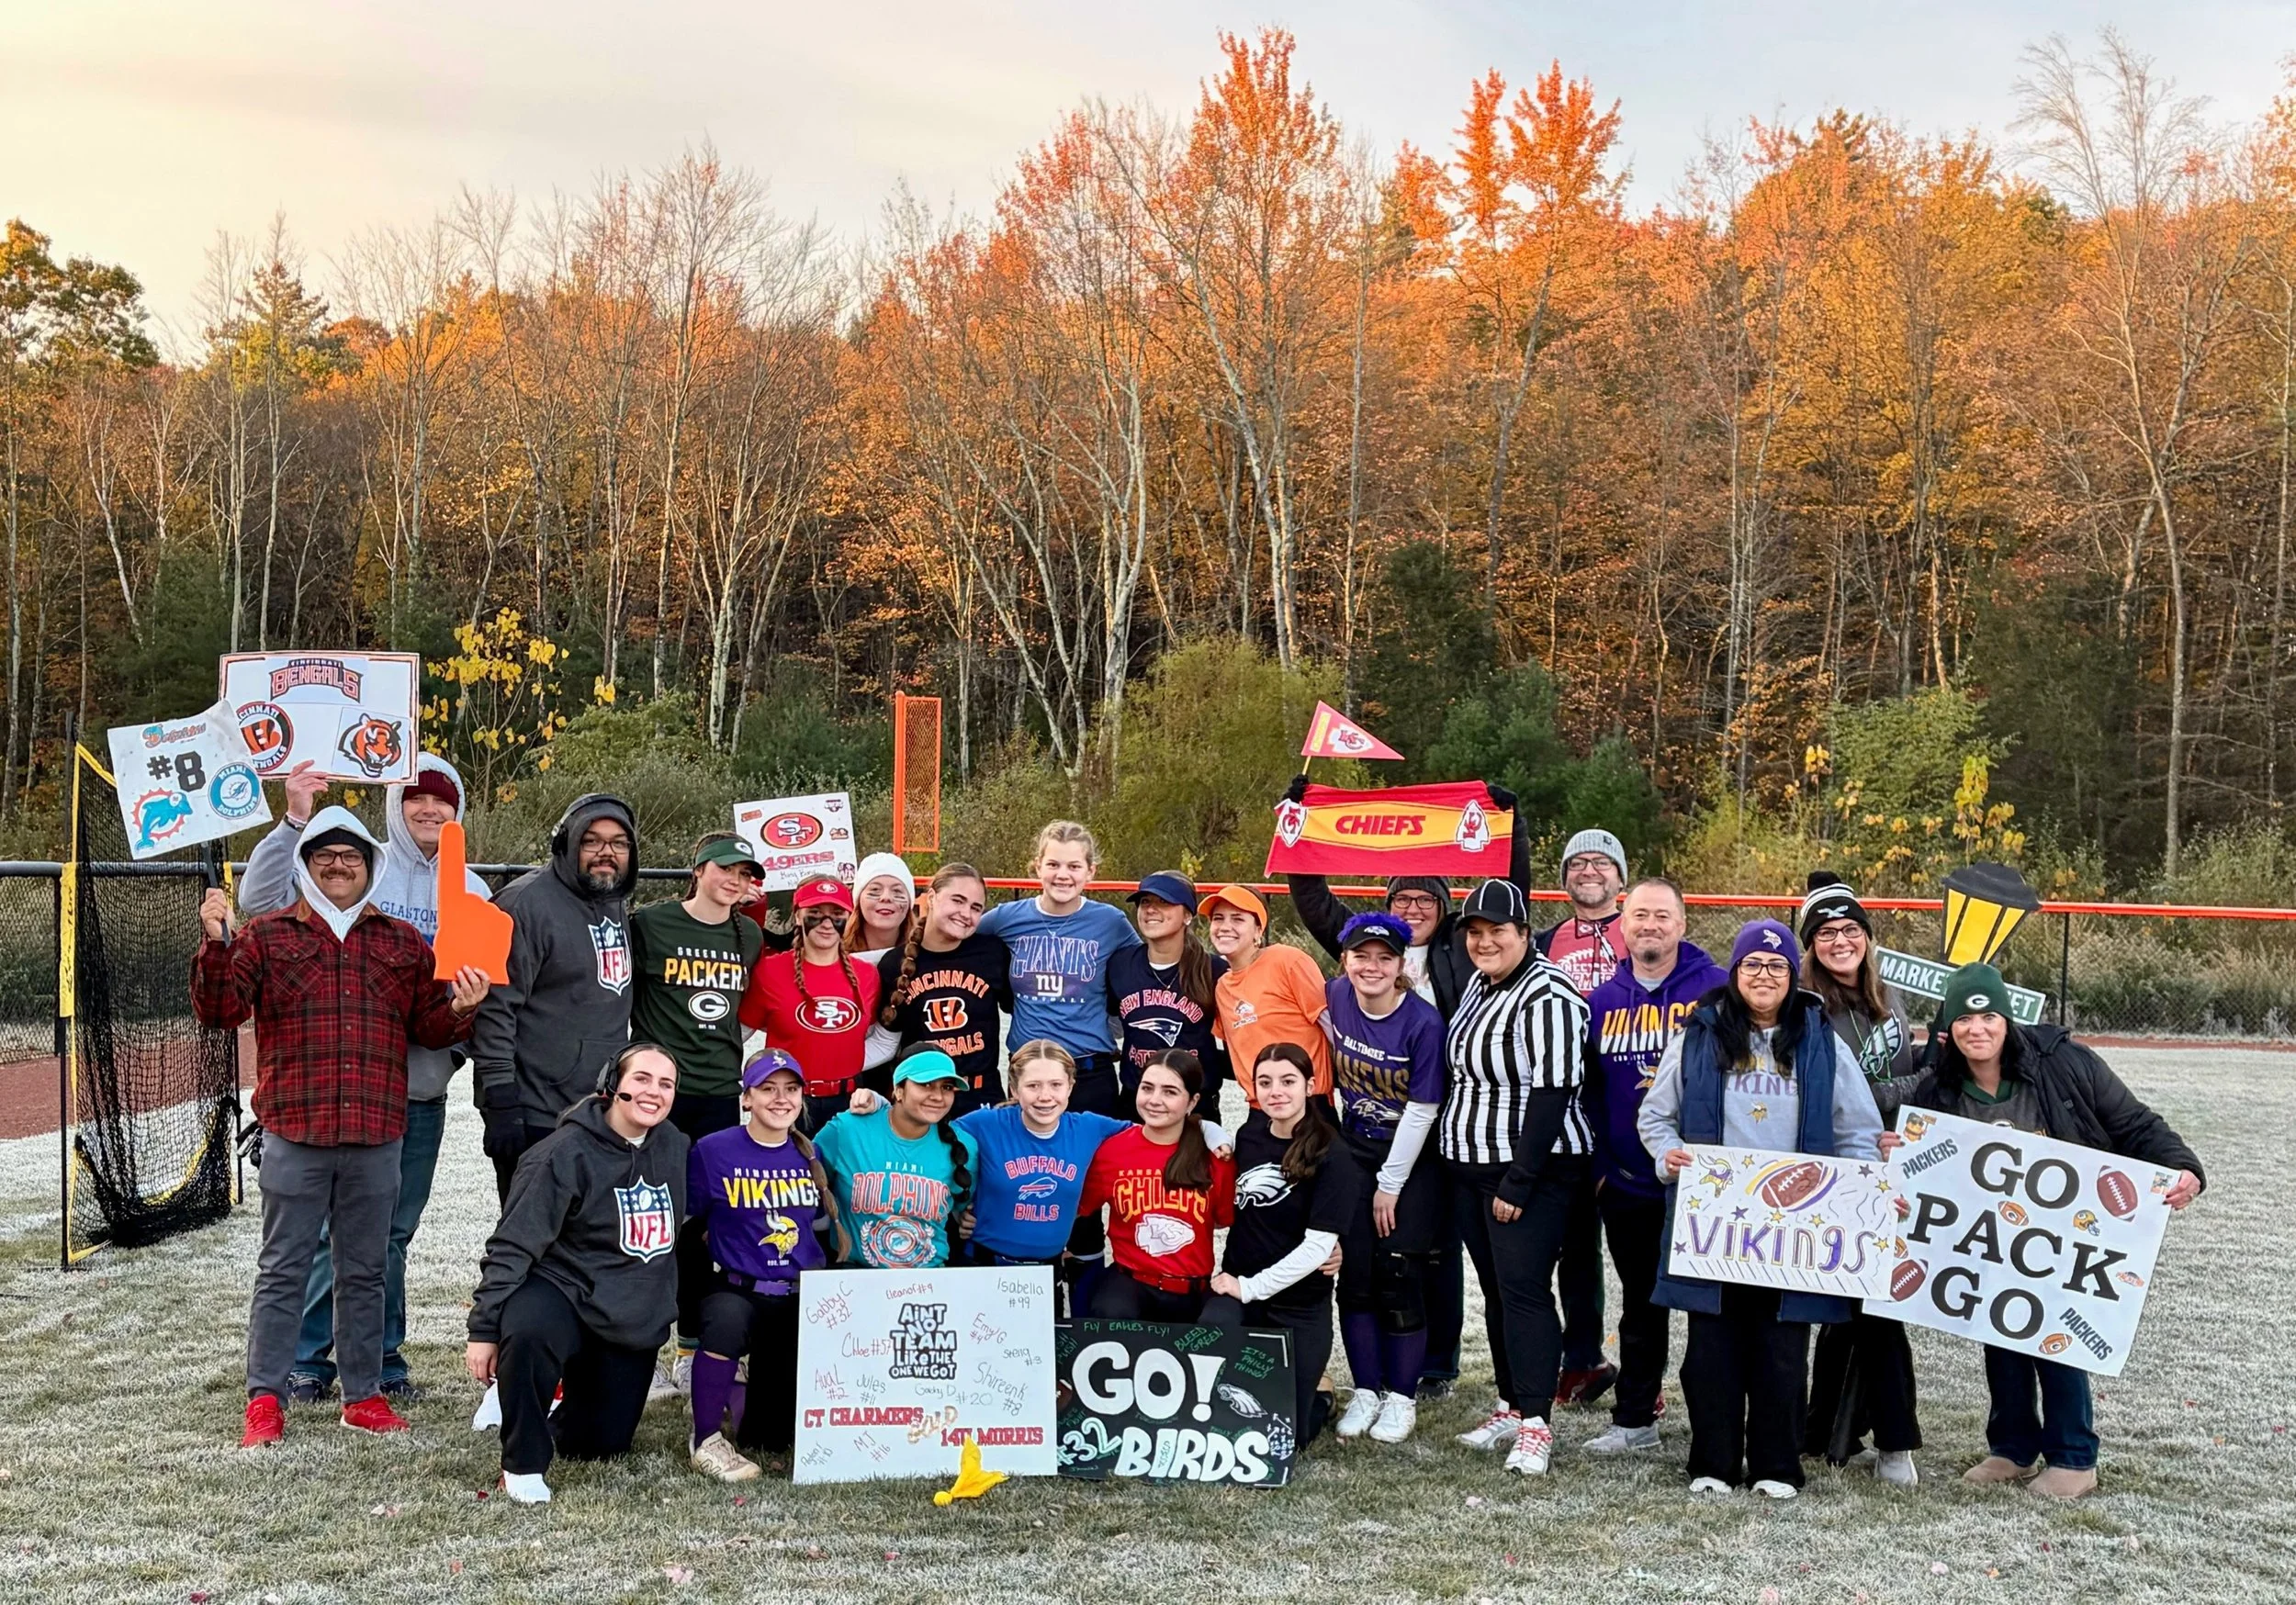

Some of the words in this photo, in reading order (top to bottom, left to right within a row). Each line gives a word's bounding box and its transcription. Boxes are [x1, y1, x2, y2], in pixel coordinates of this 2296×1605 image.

[272, 666, 359, 700] BENGALS
[147, 750, 207, 792] #8
[218, 765, 247, 780] MIAMI
[1335, 815, 1426, 836] CHIEFS
[763, 850, 835, 870] 49ERS
[602, 950, 629, 982] NFL
[677, 946, 717, 960] GREEN
[723, 950, 741, 962] BAY
[1013, 935, 1098, 982] GIANTS
[1142, 988, 1204, 1024] ENGLAND
[1344, 1035, 1385, 1061] BALTIMORE
[885, 1161, 924, 1174] MIAMI
[1005, 1155, 1077, 1182] BUFFALO
[1901, 1138, 1960, 1180] PACKERS
[734, 1167, 812, 1179] MINNESOTA
[1970, 1142, 2079, 1209] GO
[851, 1171, 951, 1223] DOLPHINS
[1014, 1202, 1060, 1222] BILLS
[628, 1214, 671, 1250] NFL
[1907, 1192, 2128, 1301] PACK
[996, 1276, 1044, 1296] Isabella
[806, 1293, 847, 1324] Gabby
[1008, 1296, 1030, 1309] #99
[1930, 1266, 2044, 1340] GO
[827, 1306, 852, 1330] #32
[906, 1318, 937, 1340] NO
[1084, 1321, 1100, 1333] FLY
[1109, 1321, 1144, 1331] EAGLES
[841, 1332, 870, 1358] Chloe
[870, 1338, 893, 1357] #57
[890, 1330, 957, 1351] TEAM
[1174, 1327, 1208, 1352] BLEED
[1190, 1326, 1224, 1352] GREEN
[2058, 1307, 2113, 1361] PACKERS
[929, 1351, 952, 1365] THE
[890, 1365, 912, 1377] ONE
[913, 1364, 929, 1377] WE
[1072, 1341, 1227, 1423] GO!
[856, 1374, 887, 1394] Jules
[954, 1391, 994, 1407] #20
[1002, 1397, 1023, 1417] #8
[804, 1408, 825, 1429] CT
[829, 1407, 924, 1427] CHARMERS
[976, 1426, 1044, 1446] MORRIS
[1114, 1426, 1270, 1484] BIRDS
